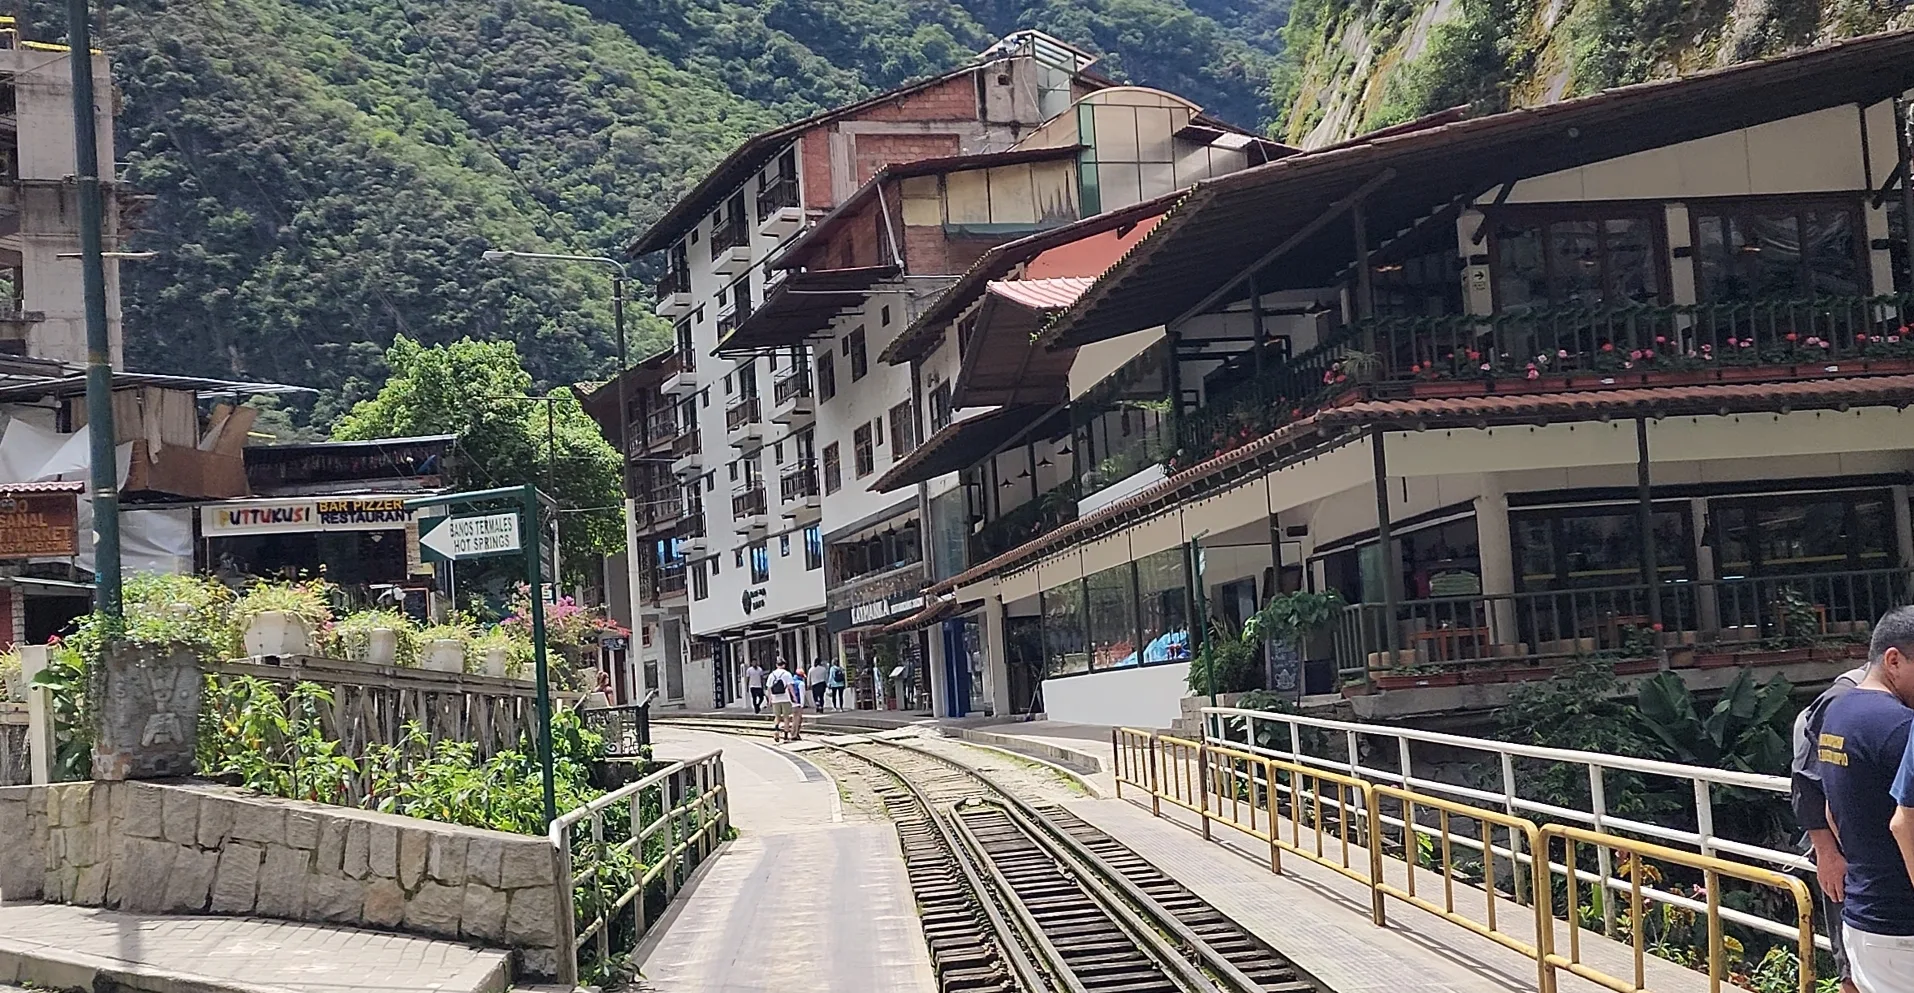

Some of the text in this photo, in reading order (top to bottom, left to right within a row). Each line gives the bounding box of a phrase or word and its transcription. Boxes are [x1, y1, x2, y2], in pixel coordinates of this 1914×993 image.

[320, 500, 403, 512] BAR PIZZER
[219, 506, 310, 527] PUTTUKUSI
[321, 510, 414, 525] RESTAURANT
[475, 517, 513, 535] TERMALES
[454, 534, 510, 553] HOT SPRINGS
